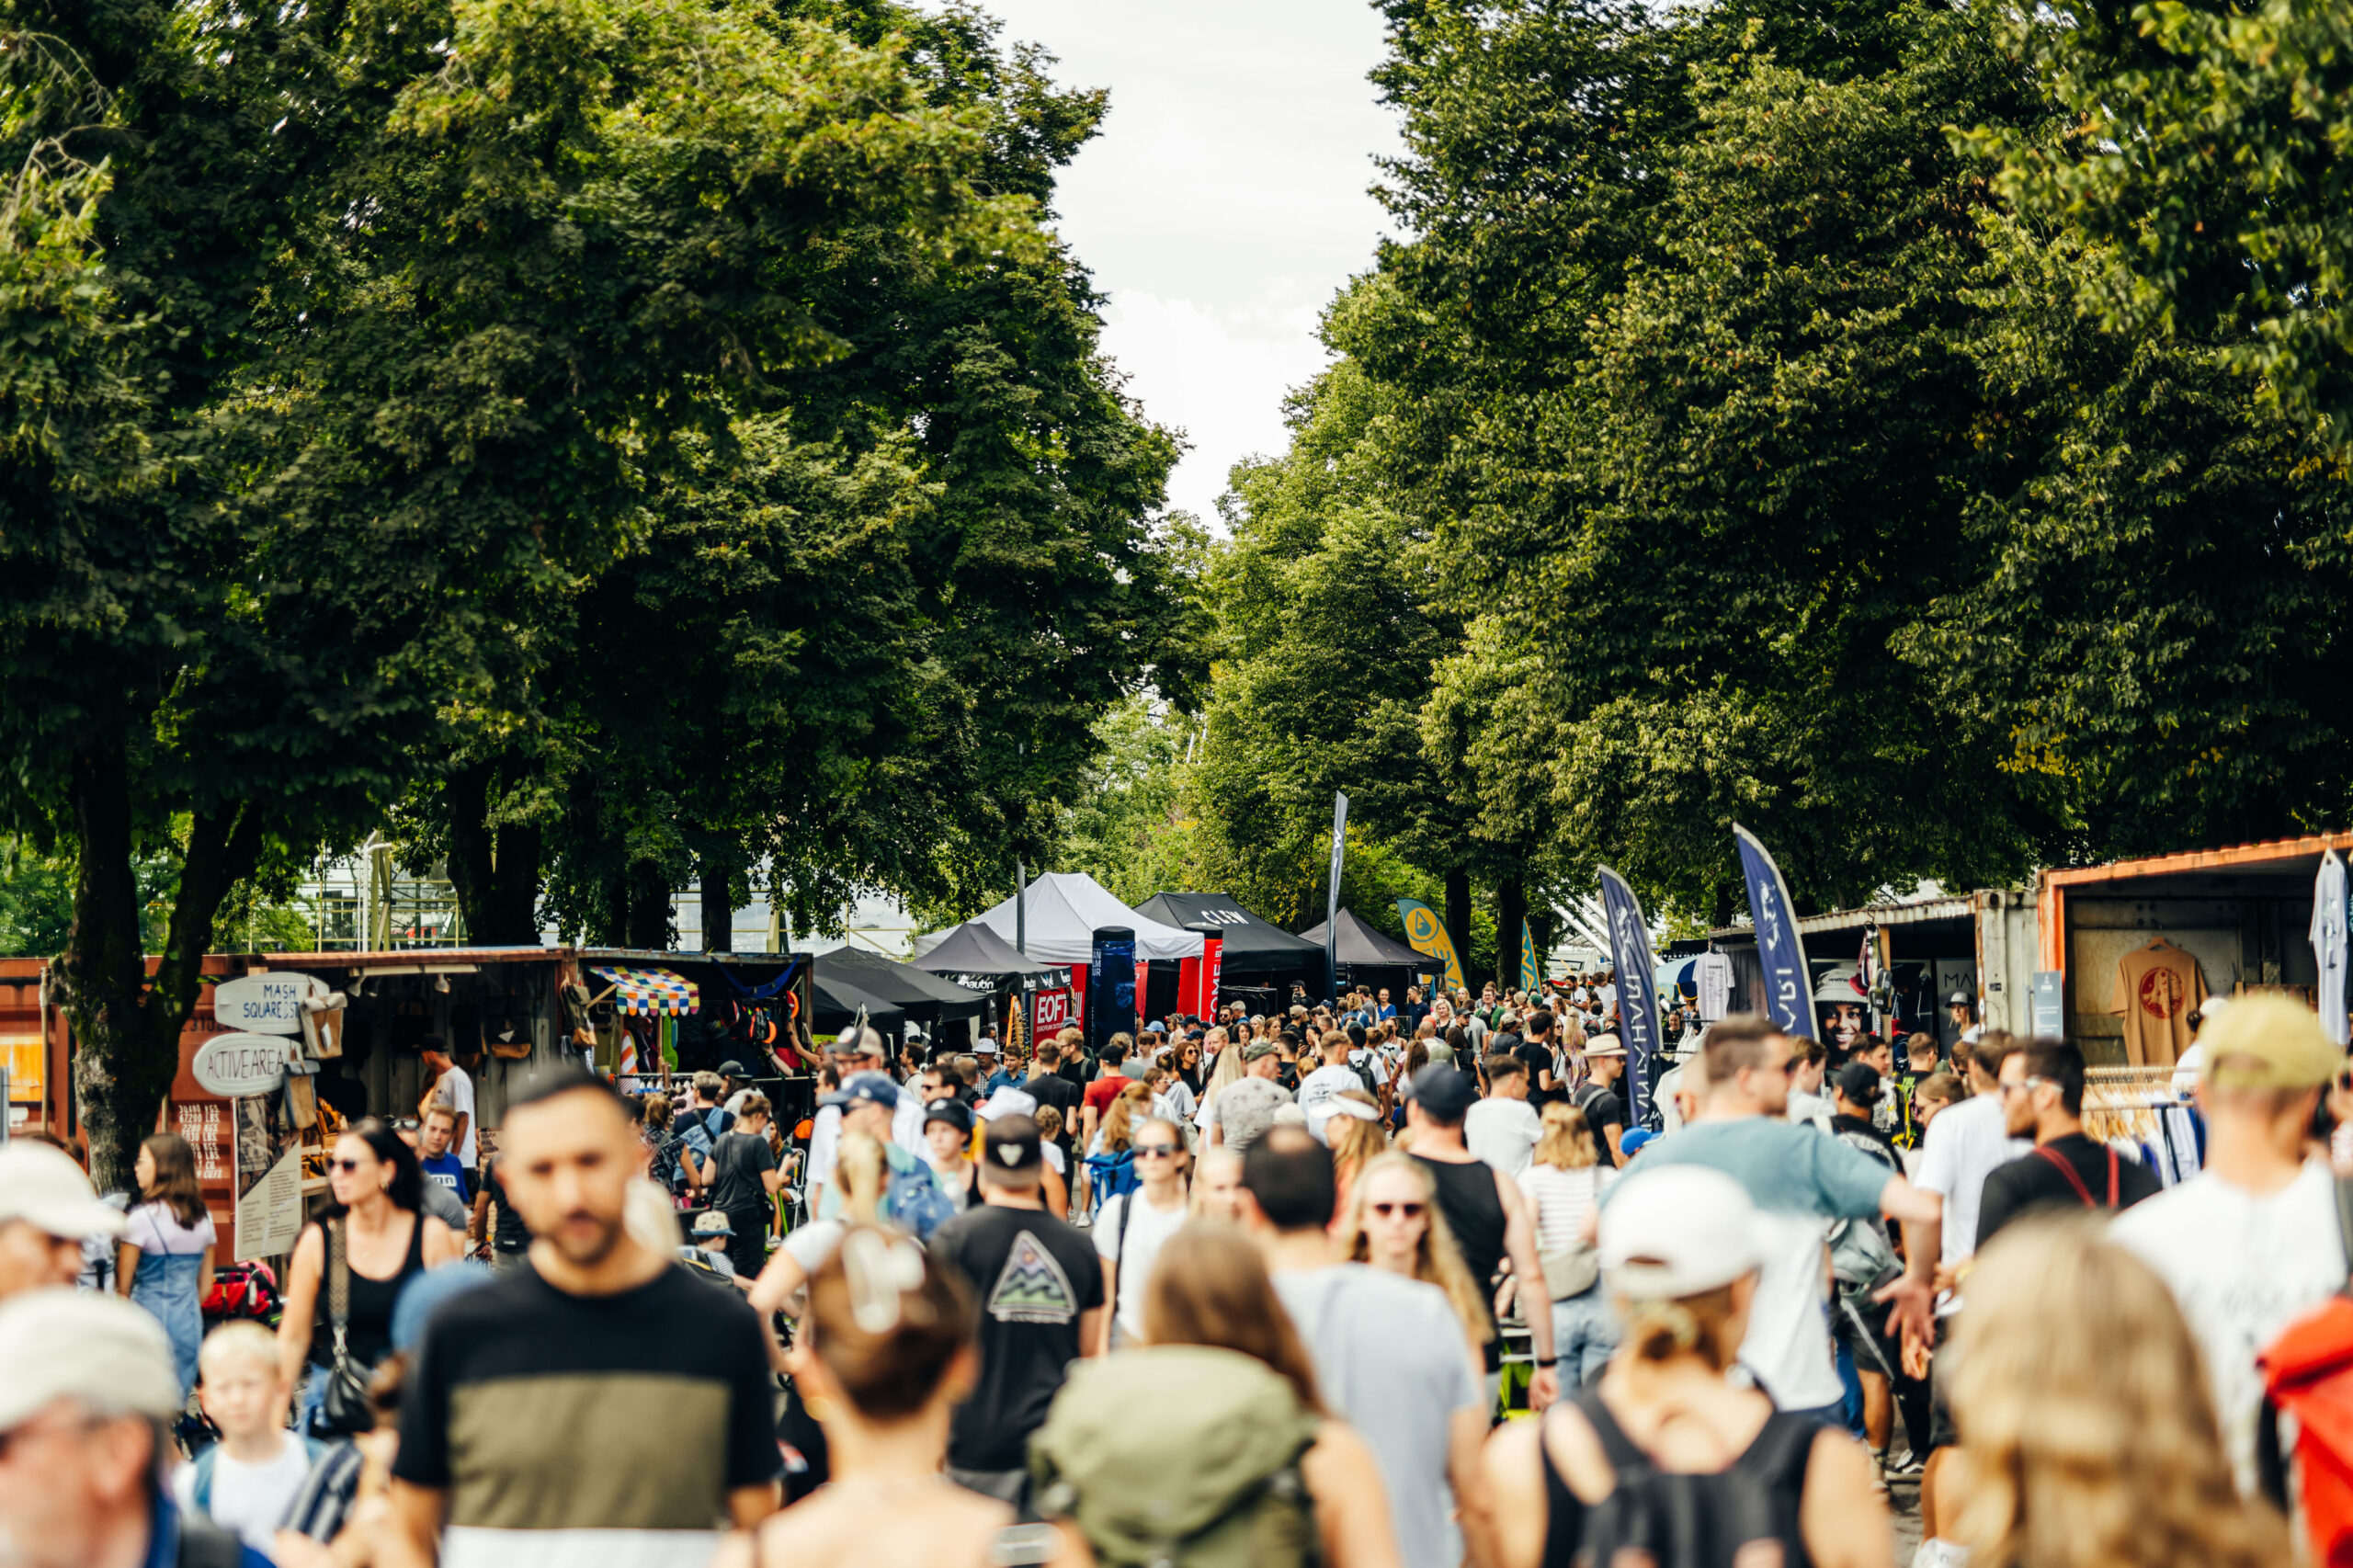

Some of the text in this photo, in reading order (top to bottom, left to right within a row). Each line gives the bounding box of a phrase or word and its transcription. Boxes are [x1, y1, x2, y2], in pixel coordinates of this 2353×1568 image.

[1200, 910, 1249, 925] CLEW
[1944, 972, 1976, 989] MA
[264, 984, 295, 999] MASH
